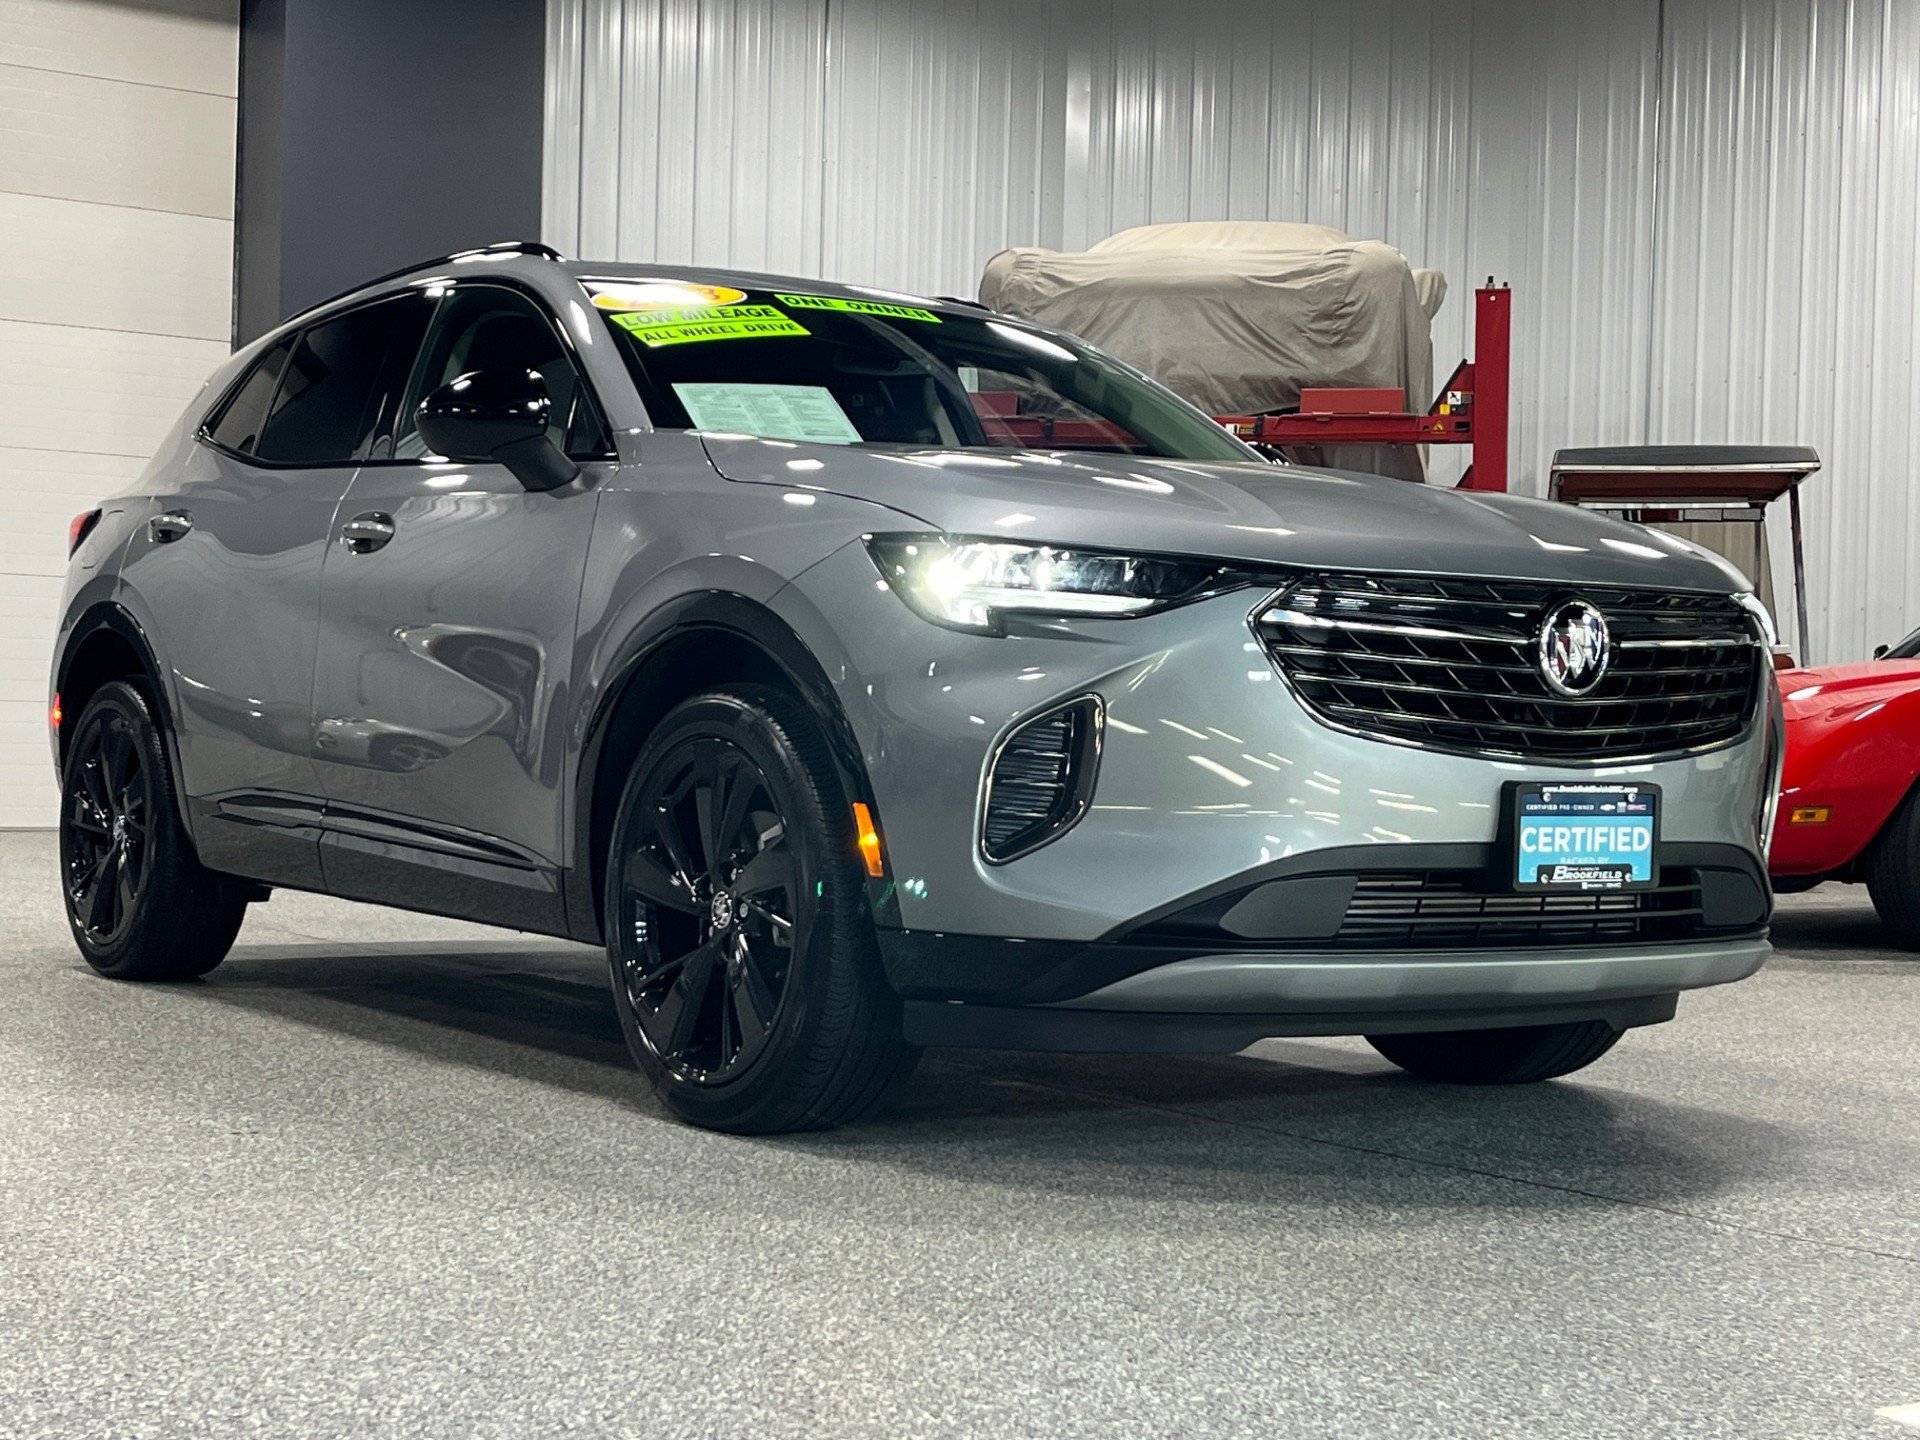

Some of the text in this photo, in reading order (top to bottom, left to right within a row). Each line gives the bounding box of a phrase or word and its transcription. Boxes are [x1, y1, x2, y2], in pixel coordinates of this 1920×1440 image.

[621, 306, 778, 327] LOW MILEAGE
[784, 296, 933, 320] ONE OWNER
[644, 319, 798, 343] ALL WHEEL DRIVE
[1520, 826, 1651, 853] CERTIFIED
